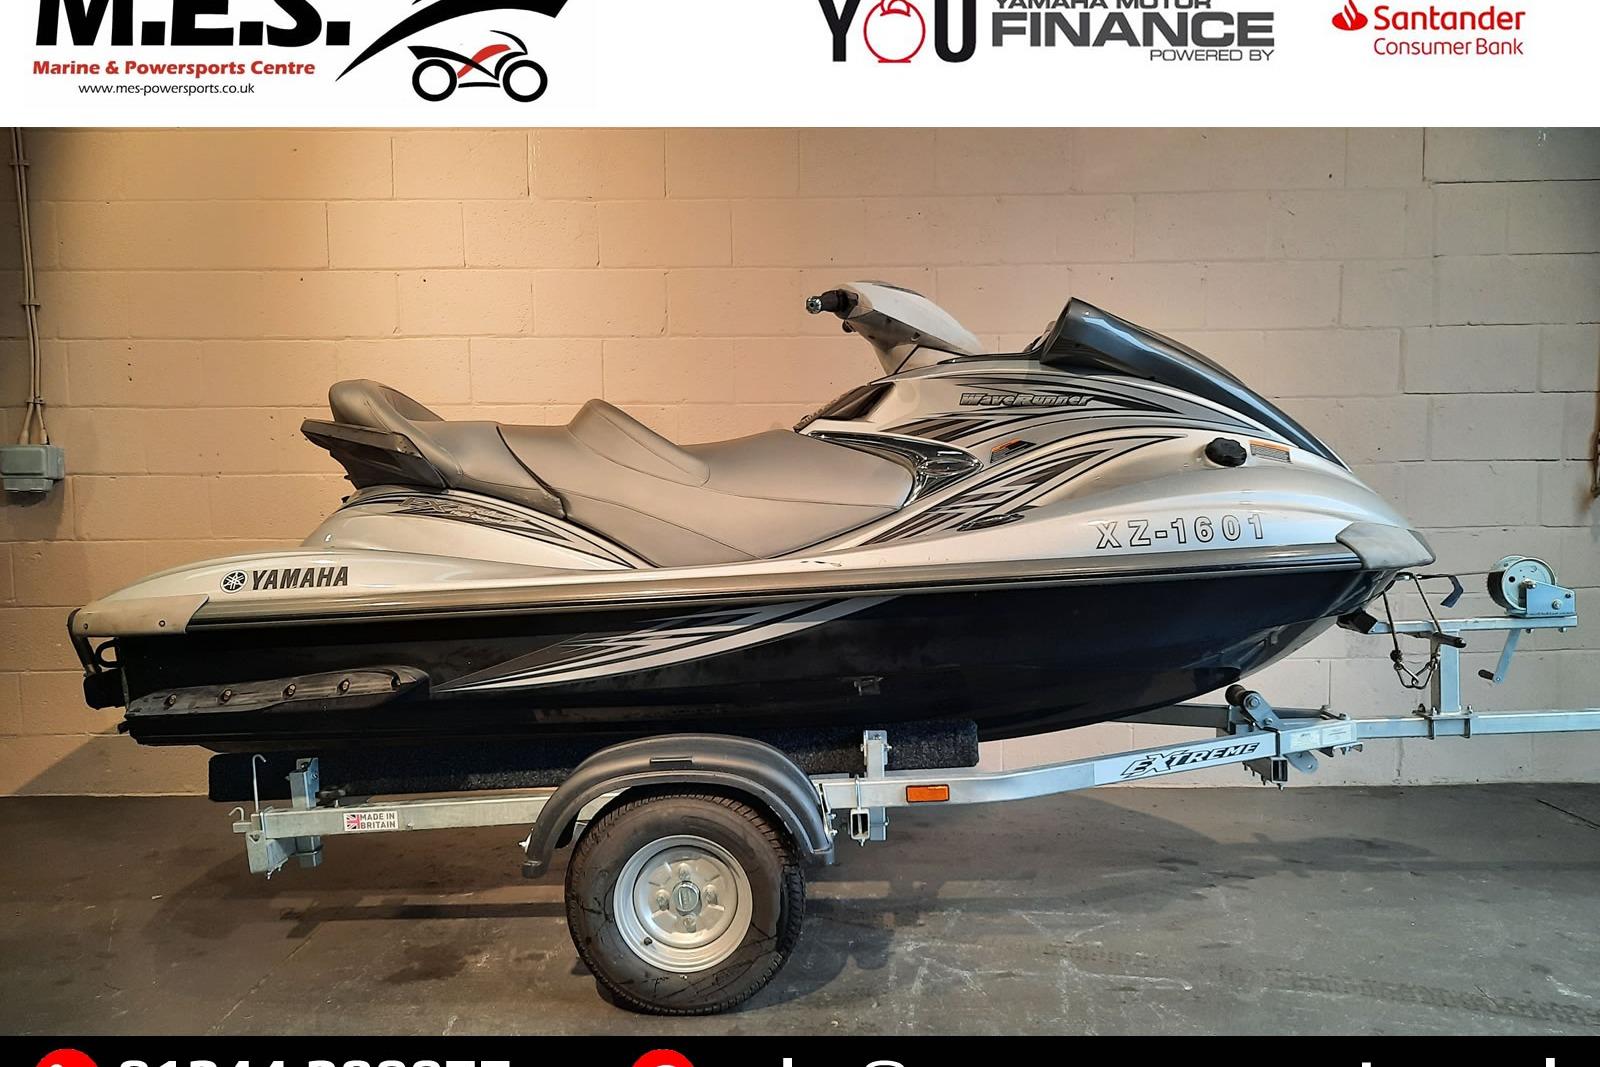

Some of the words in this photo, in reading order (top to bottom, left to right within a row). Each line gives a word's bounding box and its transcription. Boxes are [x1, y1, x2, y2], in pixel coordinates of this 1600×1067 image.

[959, 393, 1094, 407] WaveRunner
[1096, 514, 1263, 549] XZ-1601
[252, 566, 349, 590] YAMAHA
[1120, 742, 1260, 778] EXTREME
[360, 813, 384, 821] MADE
[386, 812, 395, 820] IN
[360, 821, 396, 829] BRITAIN
